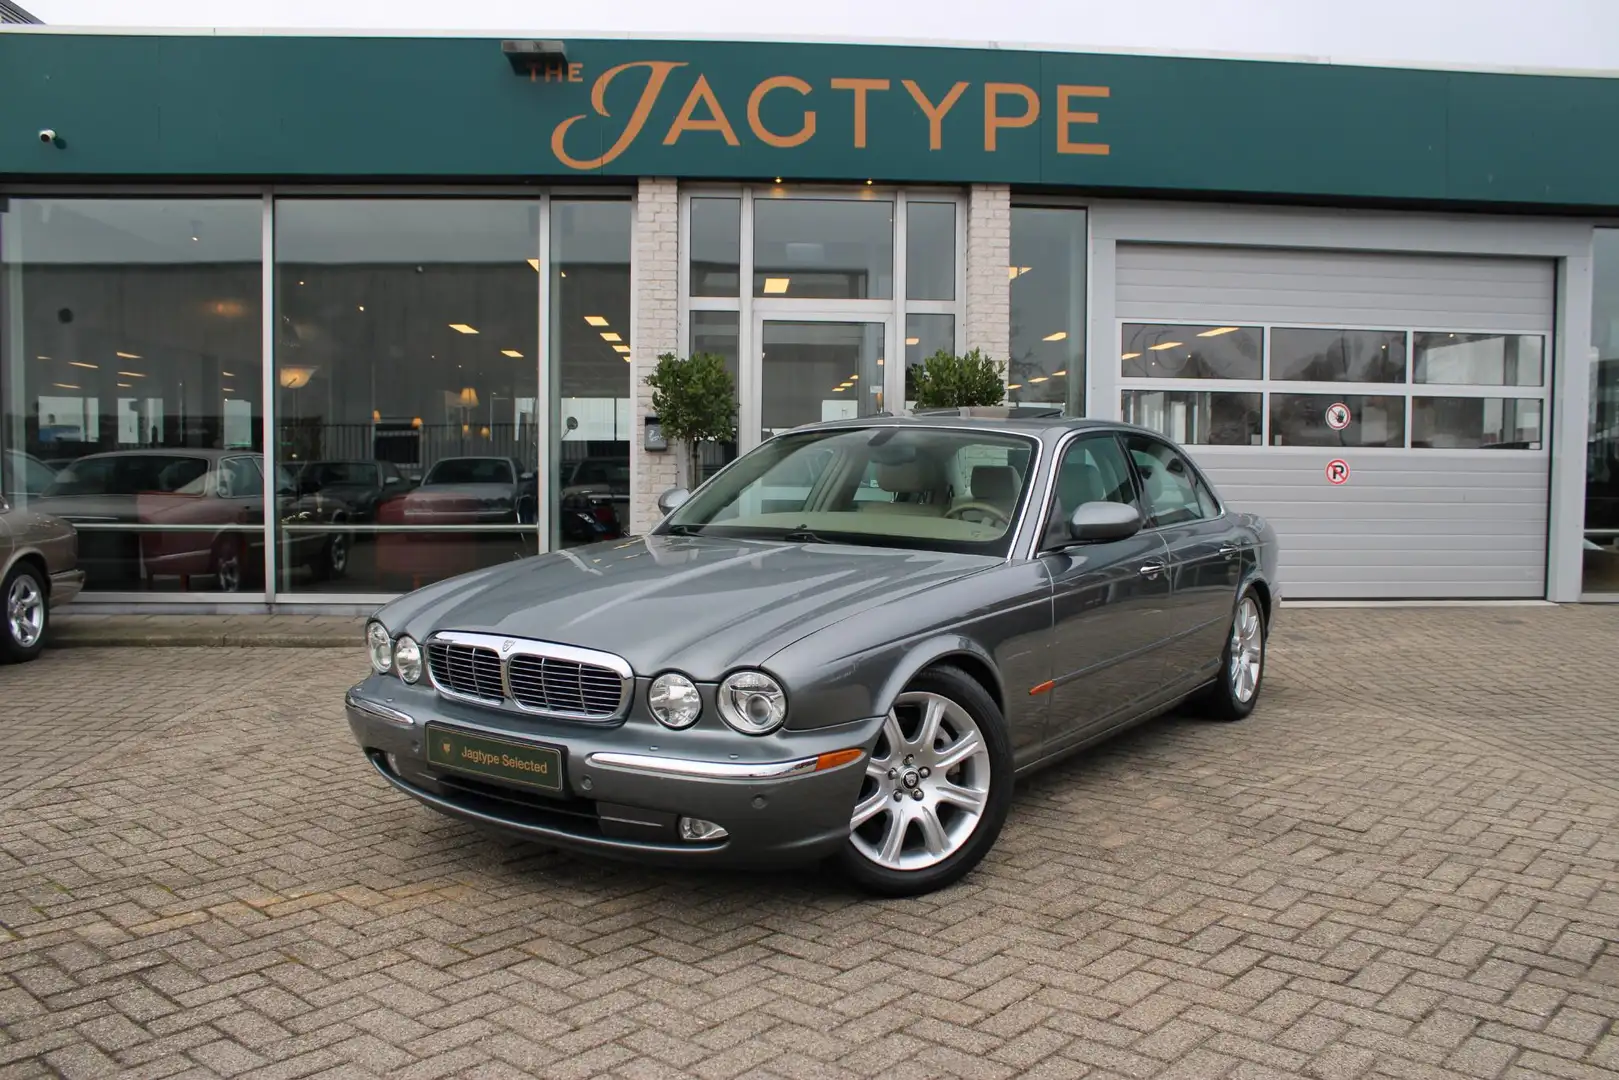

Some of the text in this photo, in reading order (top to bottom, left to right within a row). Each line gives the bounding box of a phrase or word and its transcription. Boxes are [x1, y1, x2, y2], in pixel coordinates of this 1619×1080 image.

[551, 61, 1110, 170] JAGTYPE
[1332, 464, 1345, 479] P
[461, 745, 548, 774] Jagtype Selected
